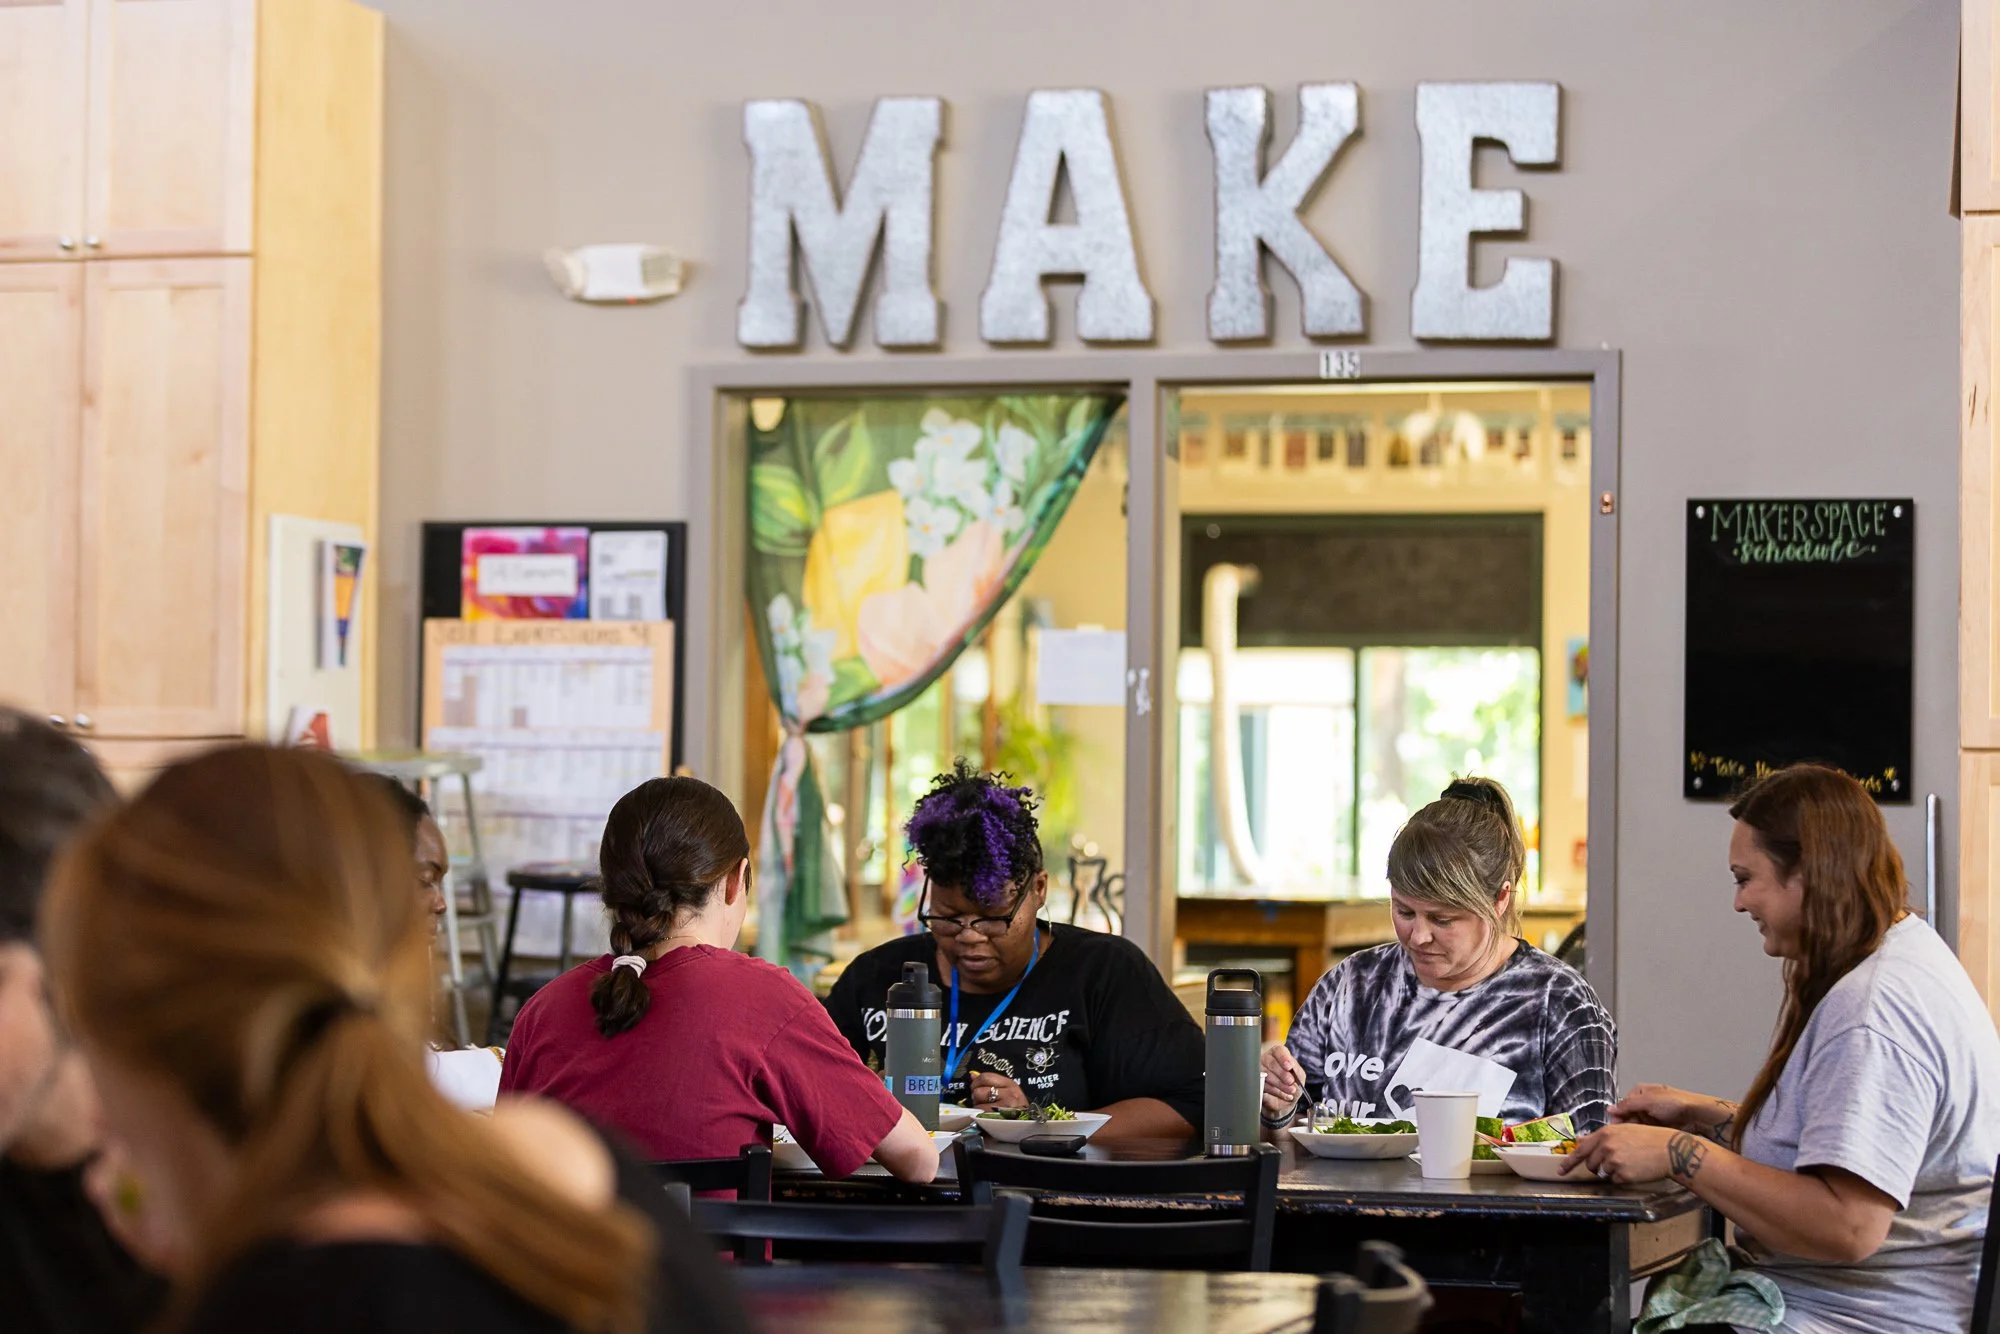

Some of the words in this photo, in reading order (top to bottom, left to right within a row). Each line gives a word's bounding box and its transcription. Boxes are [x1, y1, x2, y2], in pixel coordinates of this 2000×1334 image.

[737, 80, 1562, 349] MAKE
[1711, 502, 1887, 543] MAKERSPACE
[1740, 535, 1870, 564] schedule
[1028, 1073, 1060, 1085] MAYER
[1324, 1051, 1385, 1081] ove
